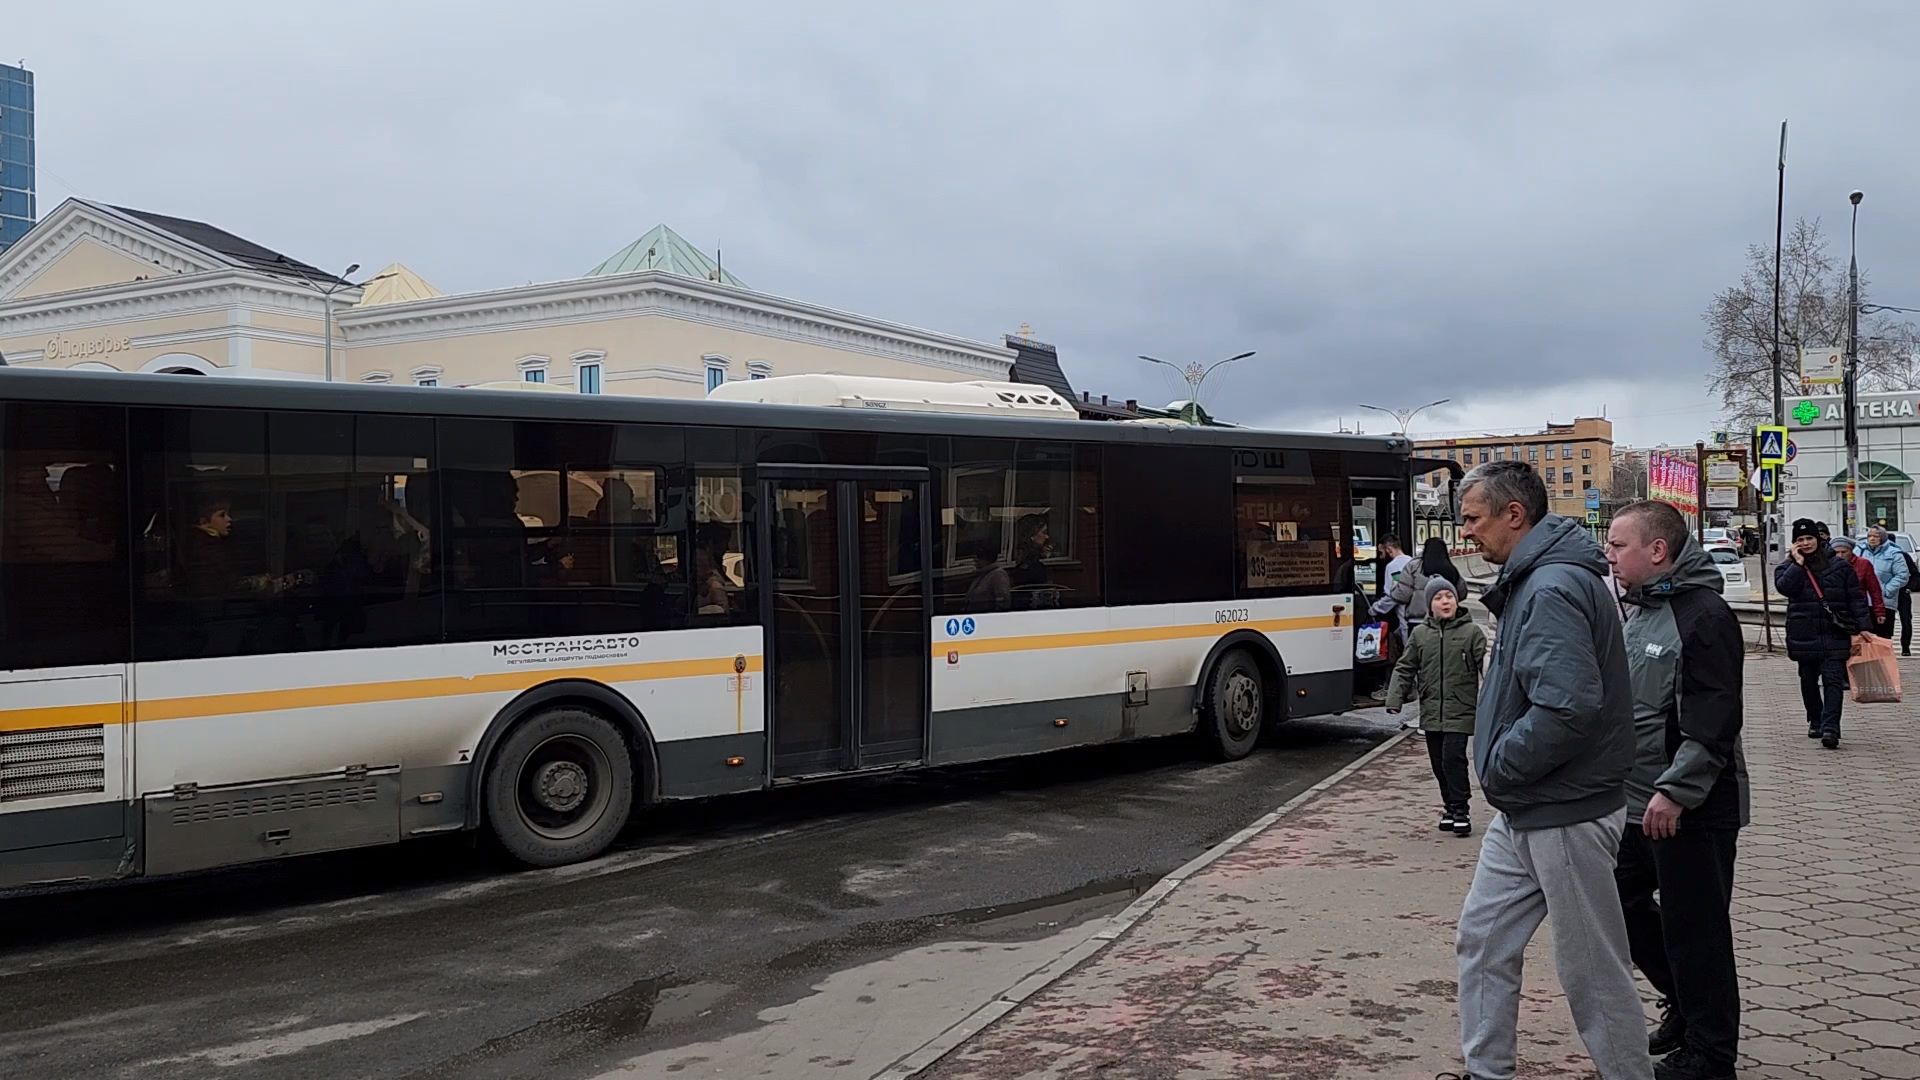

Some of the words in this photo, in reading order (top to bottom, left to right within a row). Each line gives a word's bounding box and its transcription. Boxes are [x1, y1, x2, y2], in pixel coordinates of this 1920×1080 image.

[1251, 556, 1266, 577] 339
[1214, 608, 1249, 624] 062023
[493, 637, 640, 656] МОСТРАНСАВТО
[548, 655, 584, 663] МАРШРУТЫ
